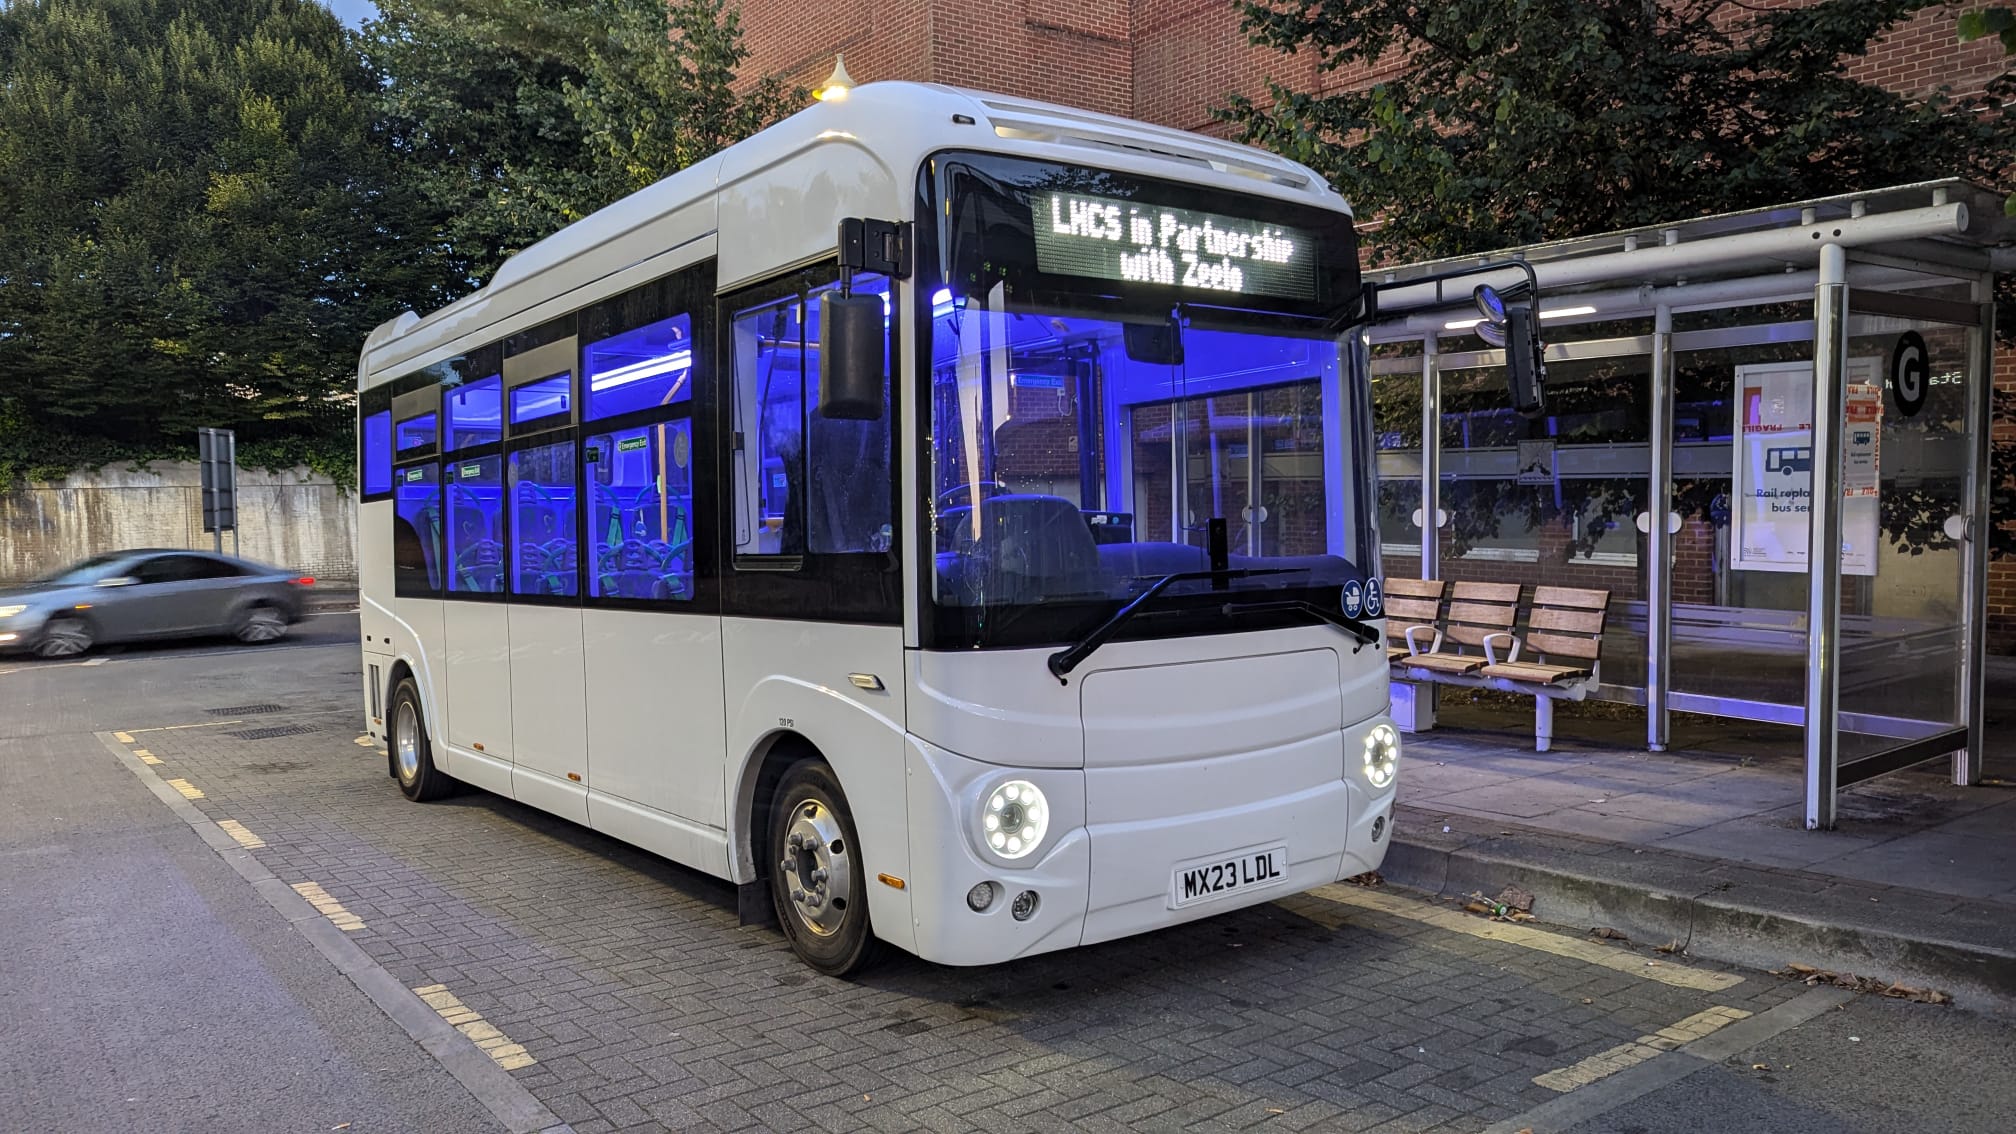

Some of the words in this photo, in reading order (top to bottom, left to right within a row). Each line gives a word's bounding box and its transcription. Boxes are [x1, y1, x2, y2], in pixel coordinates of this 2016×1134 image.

[1052, 196, 1122, 241] LHCS
[1131, 209, 1152, 245] in
[1160, 213, 1294, 263] Partnership
[1120, 248, 1174, 284] with
[1899, 346, 1920, 402] G
[1756, 488, 1777, 498] Rail
[1781, 488, 1810, 500] repla
[1772, 503, 1792, 512] bus
[1184, 862, 1237, 898] MX23
[1243, 853, 1280, 884] LDL
